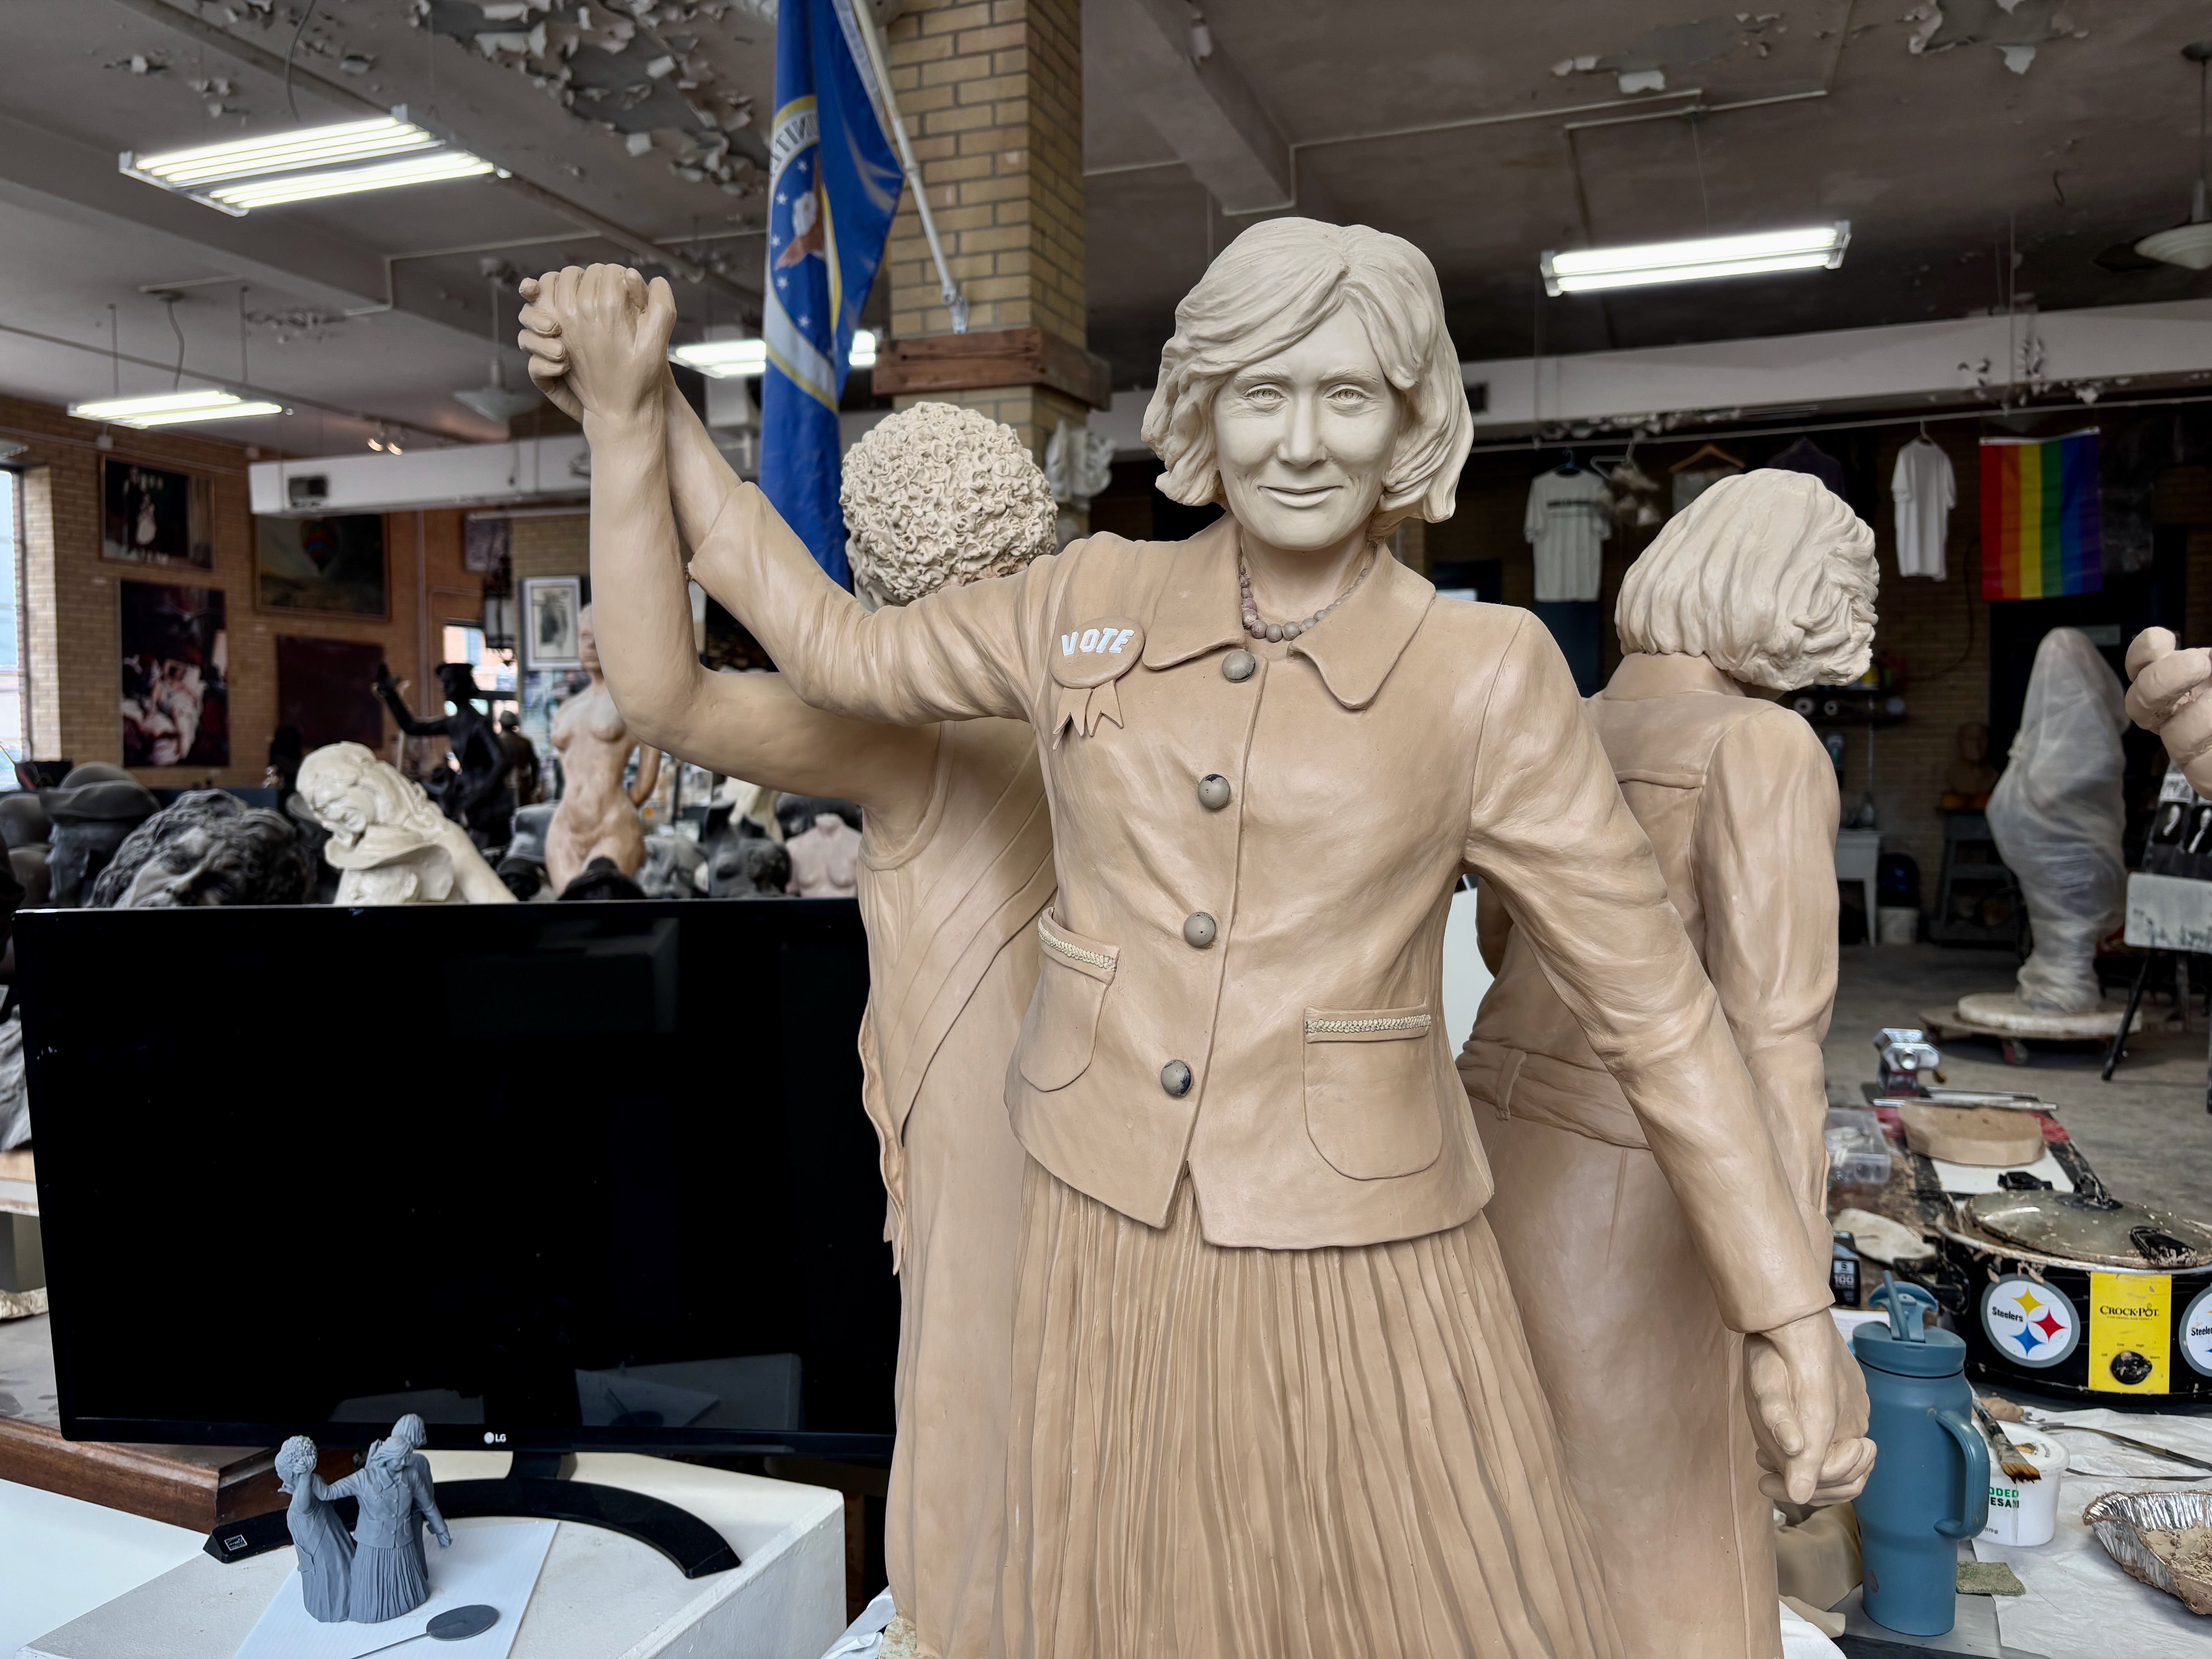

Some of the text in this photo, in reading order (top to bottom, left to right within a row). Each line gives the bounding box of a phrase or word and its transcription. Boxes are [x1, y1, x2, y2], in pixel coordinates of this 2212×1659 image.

[1061, 628, 1135, 656] VOTE
[1992, 1306, 2023, 1322] Steelers
[495, 1434, 507, 1443] LG
